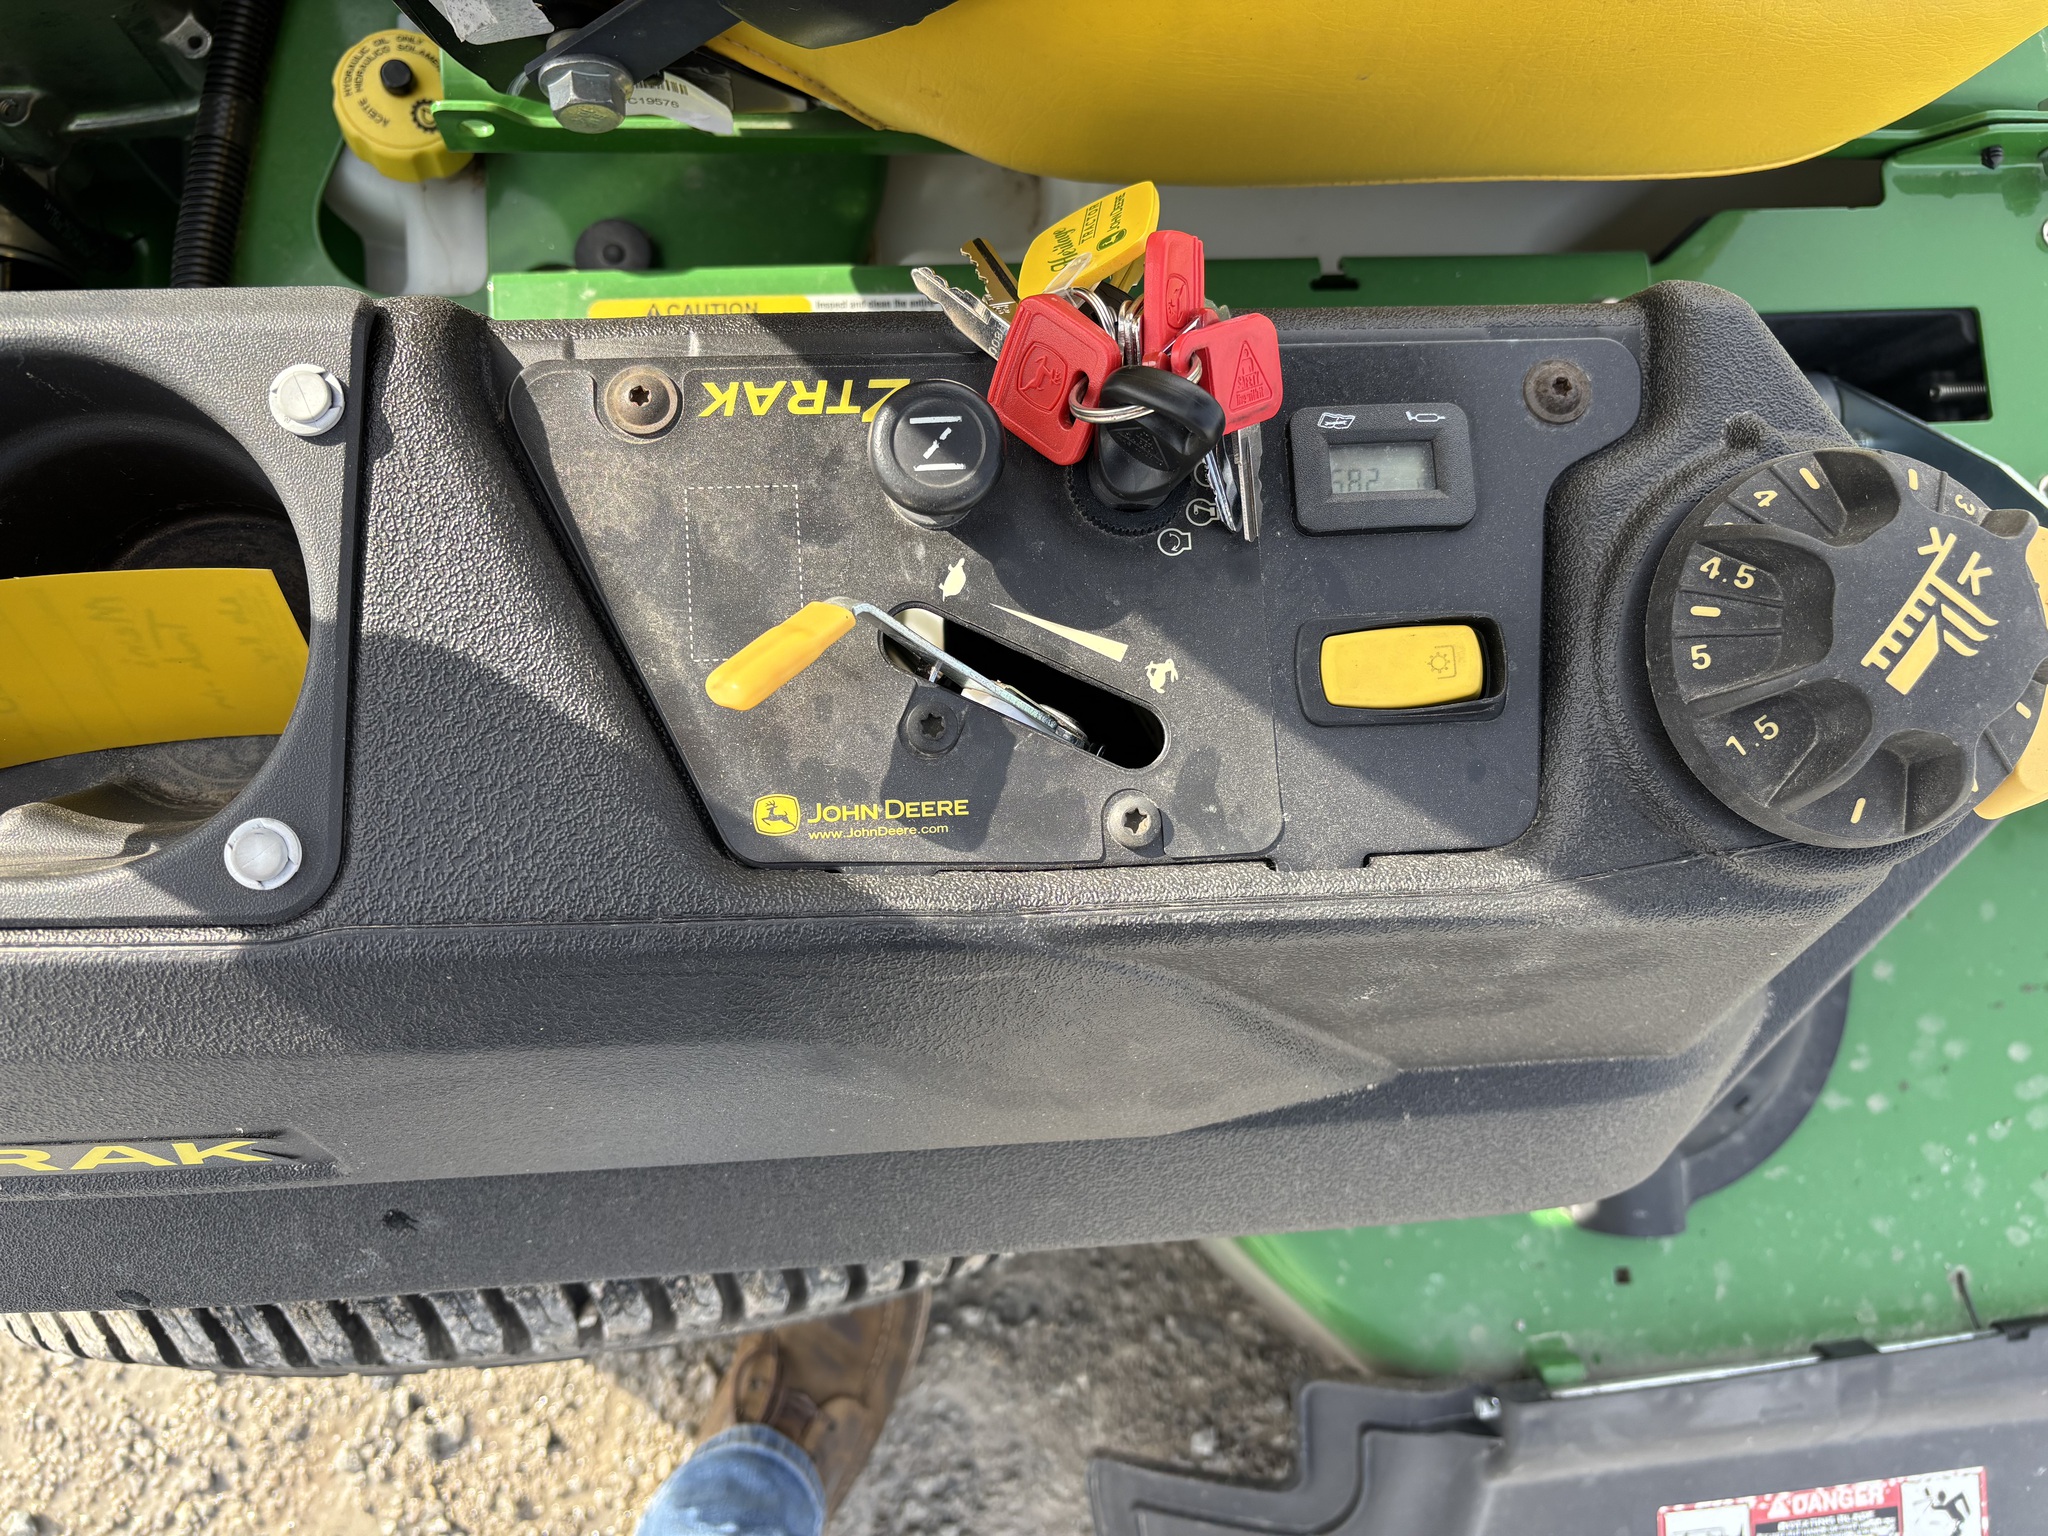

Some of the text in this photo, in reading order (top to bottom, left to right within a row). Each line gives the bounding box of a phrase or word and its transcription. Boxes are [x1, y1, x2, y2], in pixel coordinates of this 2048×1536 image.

[343, 35, 425, 97] HYDRAULIC OIL ONLY
[357, 97, 391, 128] ACEITE
[1080, 203, 1100, 245] TRACTOR
[1048, 227, 1078, 273] Heritage
[1753, 488, 1778, 508] 4
[1954, 493, 1976, 516] 3
[1699, 556, 1757, 589] 4.5
[1689, 644, 1713, 670] 5
[1725, 714, 1780, 756] 1.5
[807, 799, 970, 824] JOHN DEERE
[807, 823, 950, 841] www.JohnDeere.com
[1792, 1480, 1885, 1516] DANGER
